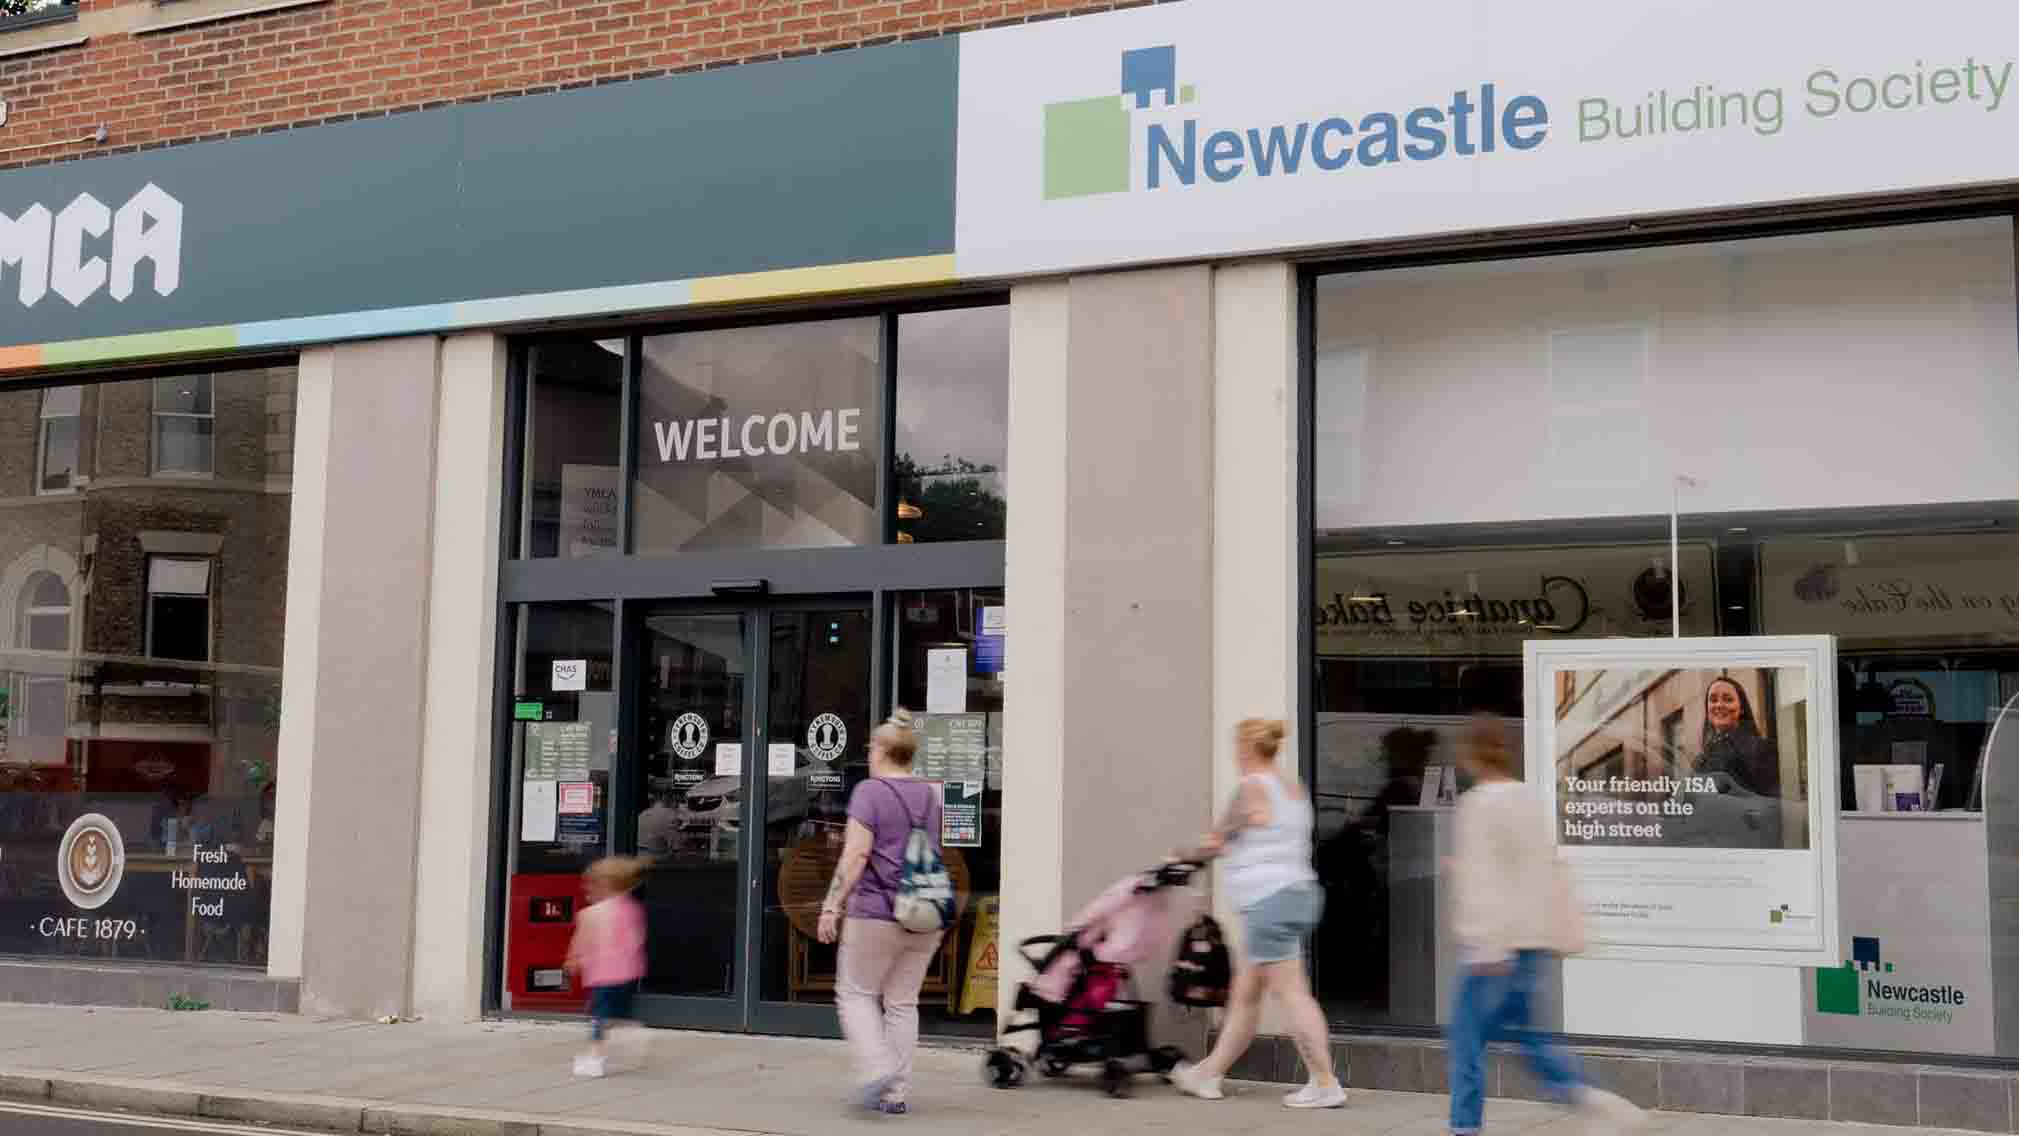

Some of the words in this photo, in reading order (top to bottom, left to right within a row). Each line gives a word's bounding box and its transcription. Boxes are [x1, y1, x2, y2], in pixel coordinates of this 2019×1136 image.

[1146, 83, 1548, 190] Newcastle
[1578, 84, 1784, 144] Building
[1804, 57, 2014, 118] Society
[654, 408, 861, 462] WELCOME
[583, 487, 617, 498] YMCA
[555, 664, 577, 674] CHAS
[1565, 776, 1607, 793] Your
[1610, 776, 1682, 796] friendly
[1685, 777, 1719, 793] ISA
[1565, 800, 1633, 818] experts
[1636, 801, 1660, 815] on
[1664, 800, 1694, 816] the
[1565, 821, 1605, 839] high
[1609, 821, 1663, 838] street
[193, 844, 229, 865] Fresh
[171, 871, 248, 891] Homemade
[191, 897, 224, 917] Food
[39, 917, 89, 938] CAFE
[93, 918, 137, 940] 1879
[1867, 979, 1965, 1006] Newcastle
[1867, 1002, 1912, 1021] Building
[1912, 1006, 1953, 1025] Society
